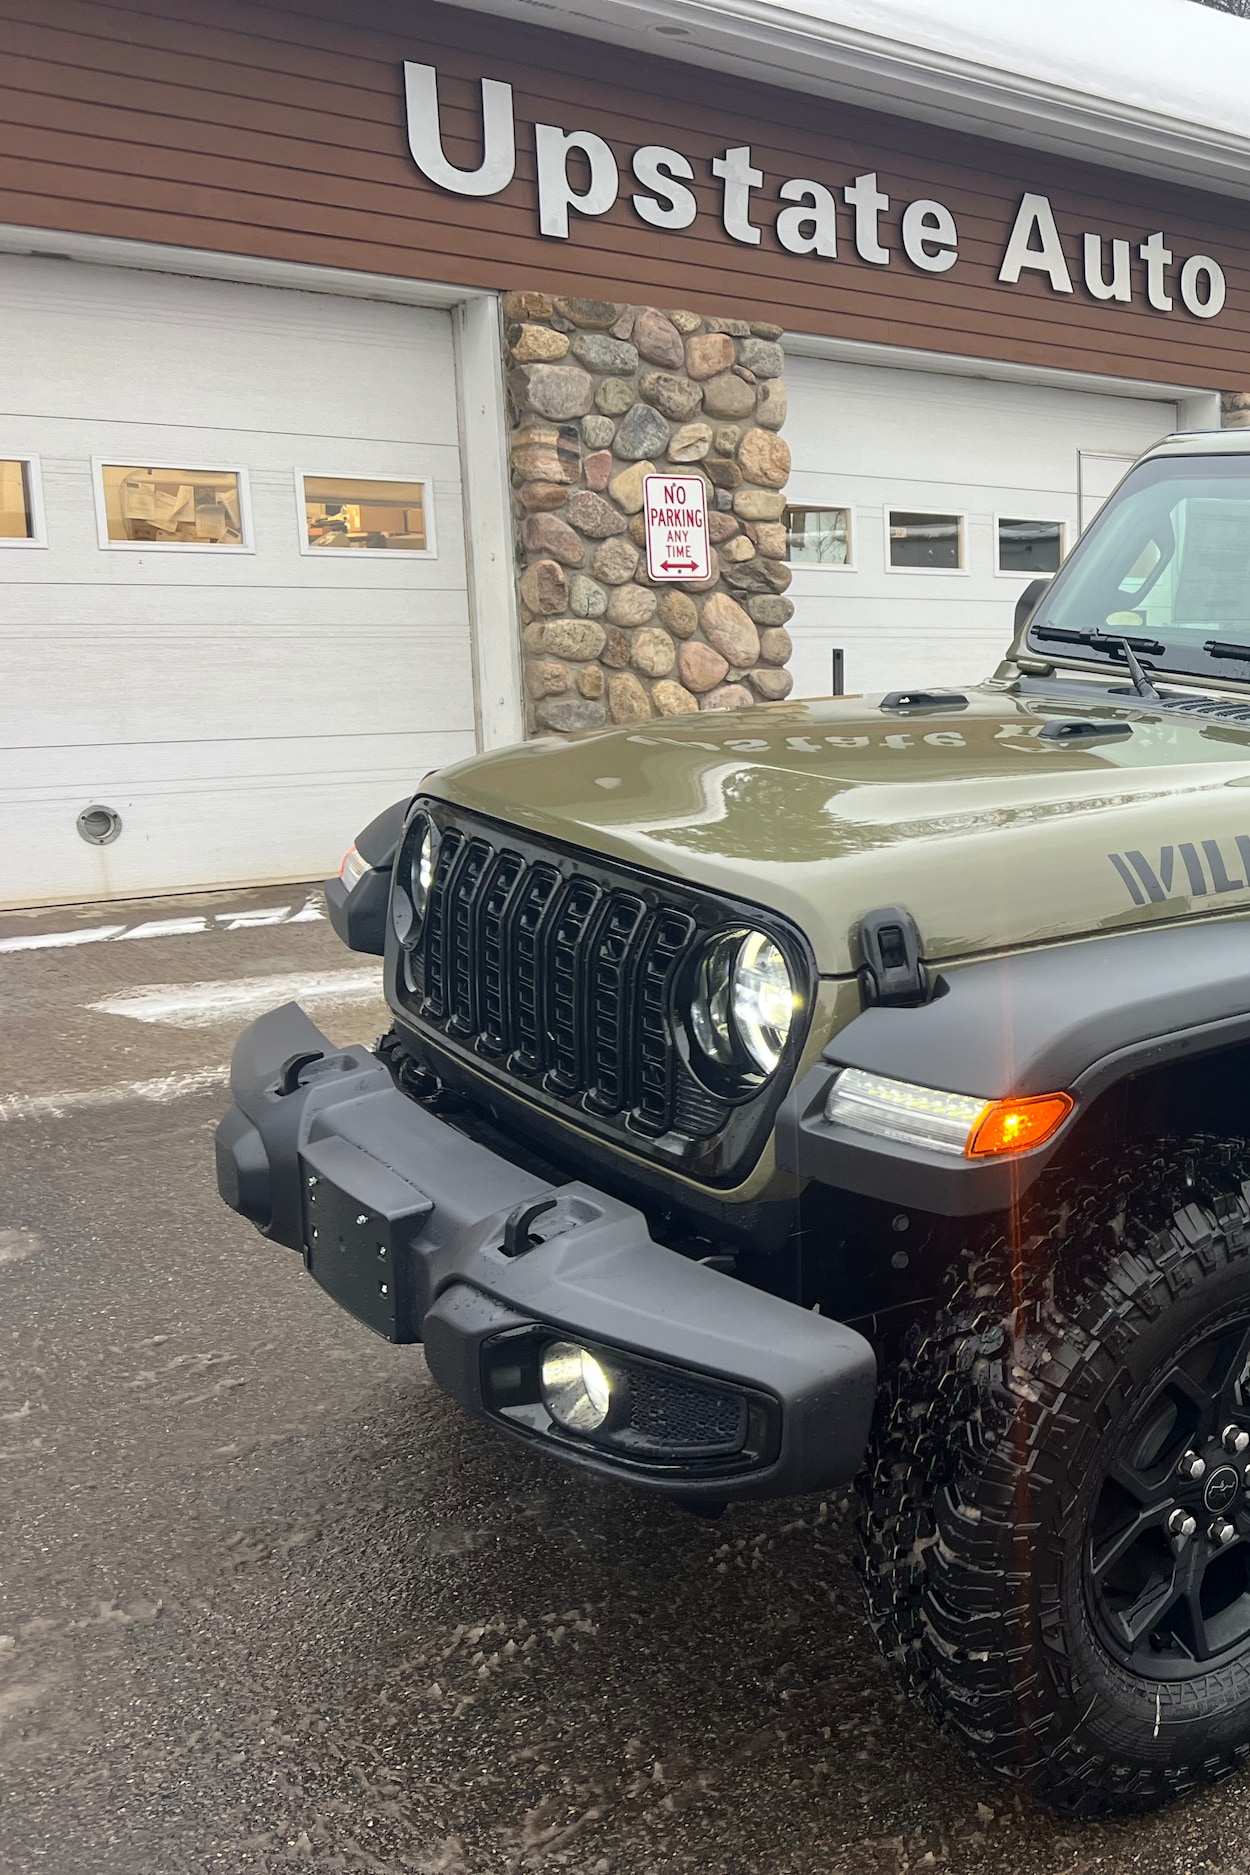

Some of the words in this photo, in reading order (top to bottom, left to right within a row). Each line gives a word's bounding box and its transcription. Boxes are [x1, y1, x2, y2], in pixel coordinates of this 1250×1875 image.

[403, 60, 960, 273] Upstate
[998, 192, 1227, 320] Auto
[664, 485, 686, 504] NO
[651, 508, 702, 528] PARKING
[667, 530, 689, 542] ANY
[666, 545, 692, 558] TIME
